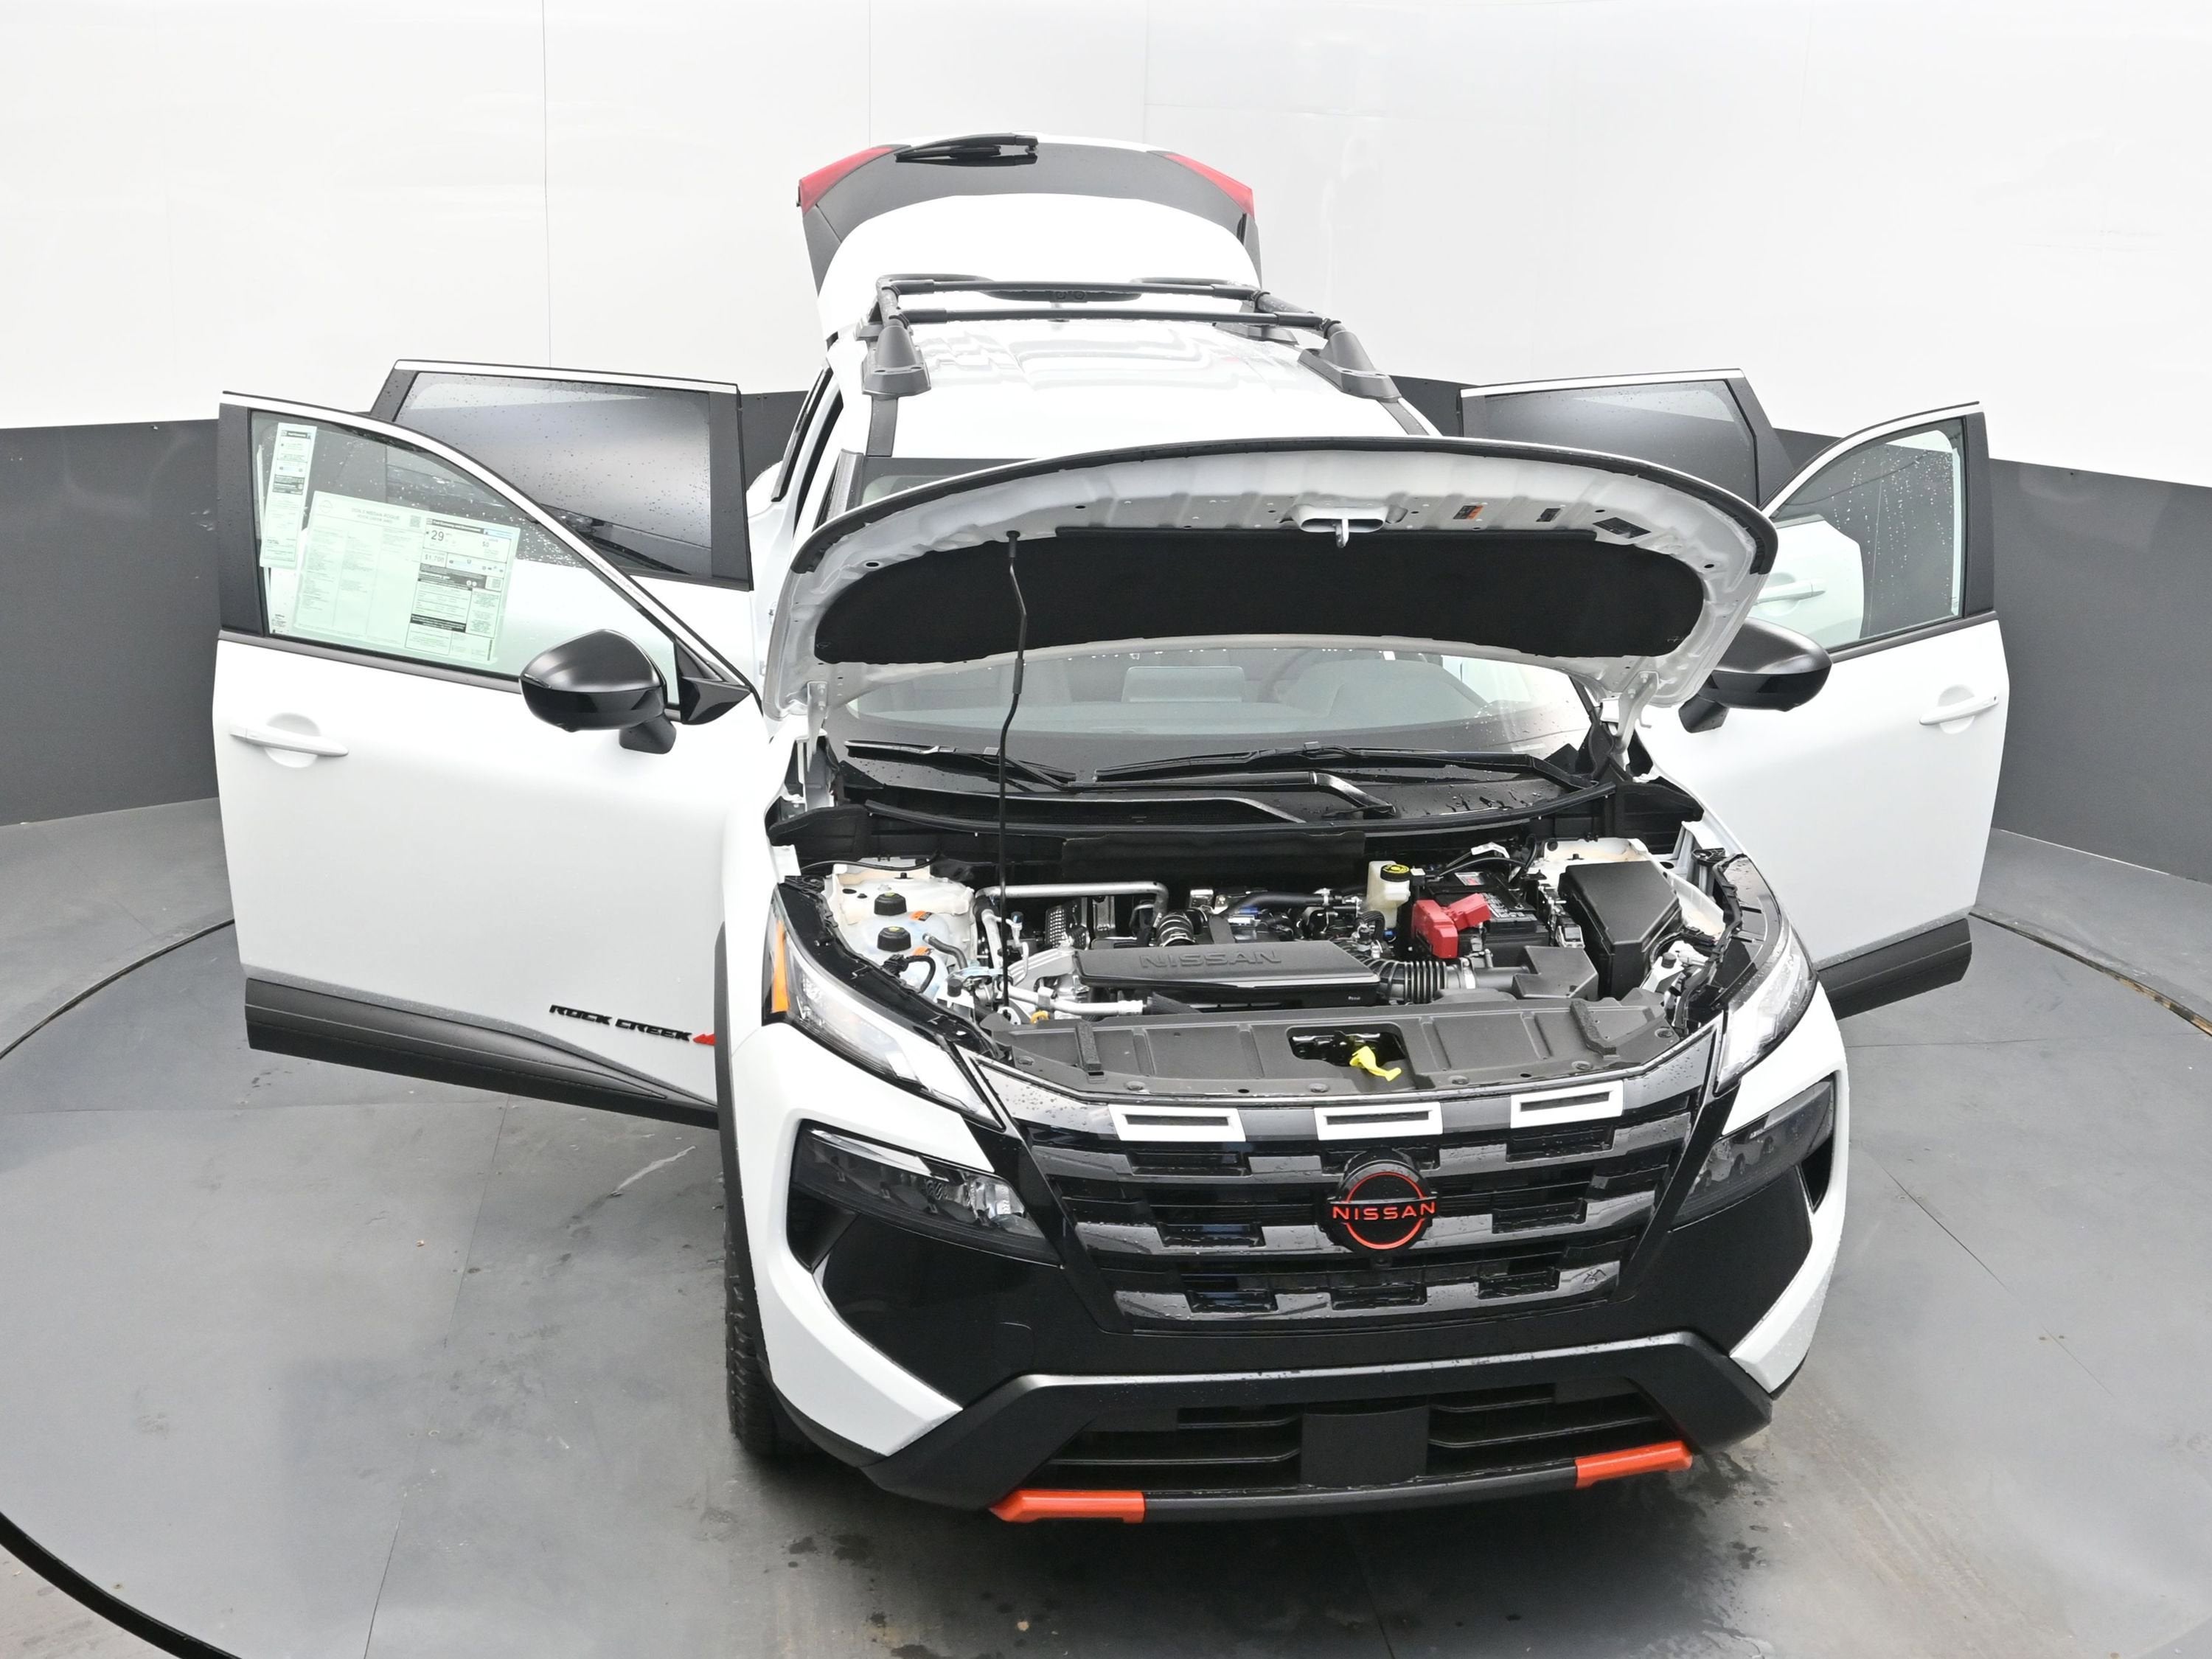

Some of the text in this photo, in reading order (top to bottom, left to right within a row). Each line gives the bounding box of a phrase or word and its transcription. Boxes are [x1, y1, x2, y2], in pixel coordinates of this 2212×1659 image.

[431, 530, 444, 541] 29
[1138, 950, 1281, 968] NISSAN
[549, 1004, 692, 1042] ROCK CREEK
[1332, 1201, 1435, 1220] NISSAN
